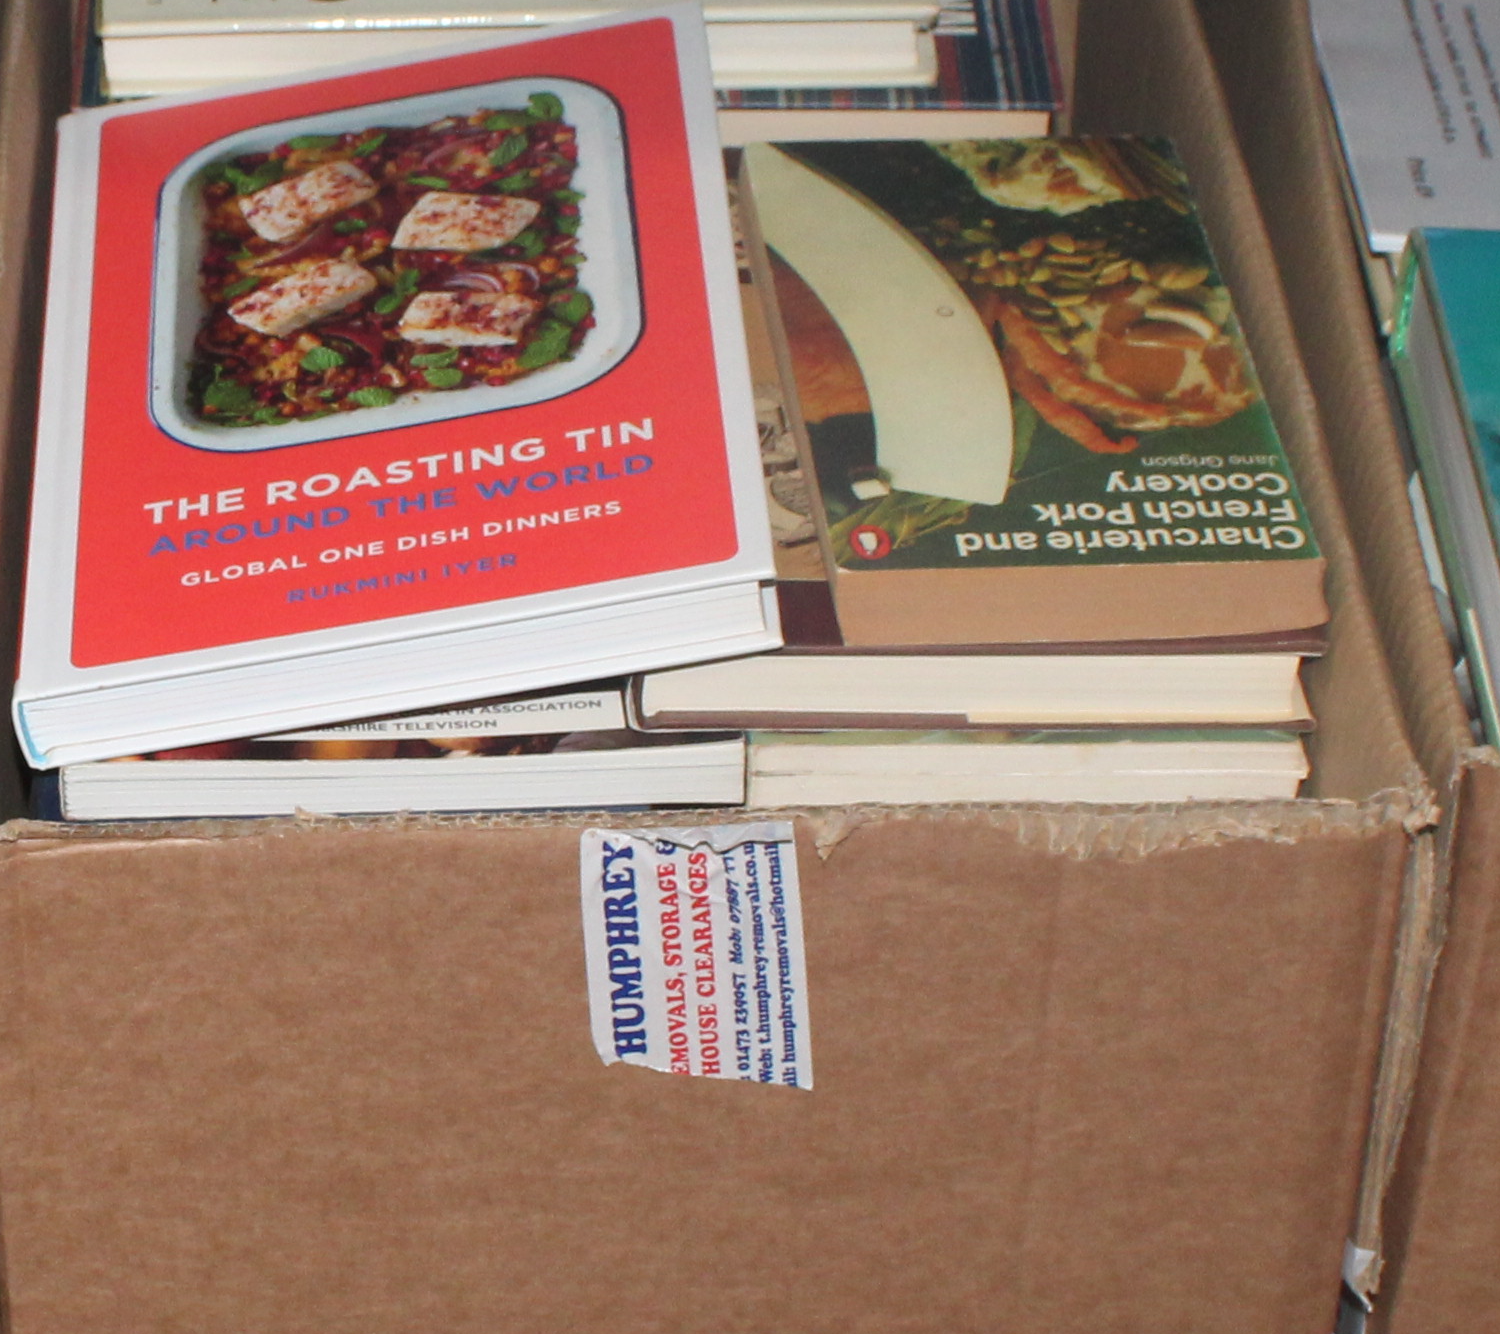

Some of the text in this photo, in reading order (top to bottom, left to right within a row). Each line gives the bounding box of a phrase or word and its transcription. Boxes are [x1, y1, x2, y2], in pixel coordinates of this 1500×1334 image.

[144, 417, 656, 526] THE ROASTING TIN
[1105, 470, 1291, 498] Cookery
[1228, 453, 1278, 468] Jane
[147, 452, 656, 558] AROUND THE WORLD
[1036, 498, 1298, 527] French Pork
[179, 499, 624, 588] GLOBAL ONE DISH DINNERS
[955, 524, 1306, 557] Charcuterie and
[286, 551, 518, 604] RUKMINI IYER
[392, 719, 498, 732] TELEVISION
[478, 698, 602, 715] ASSOCIATION
[657, 862, 684, 966] STORAGE
[601, 840, 648, 1058] HUMPHREY
[688, 851, 721, 1075] HOUSE CLEARANCES
[732, 971, 749, 1025] 239057
[734, 1029, 750, 1072] 01473
[756, 1047, 774, 1084] Web:
